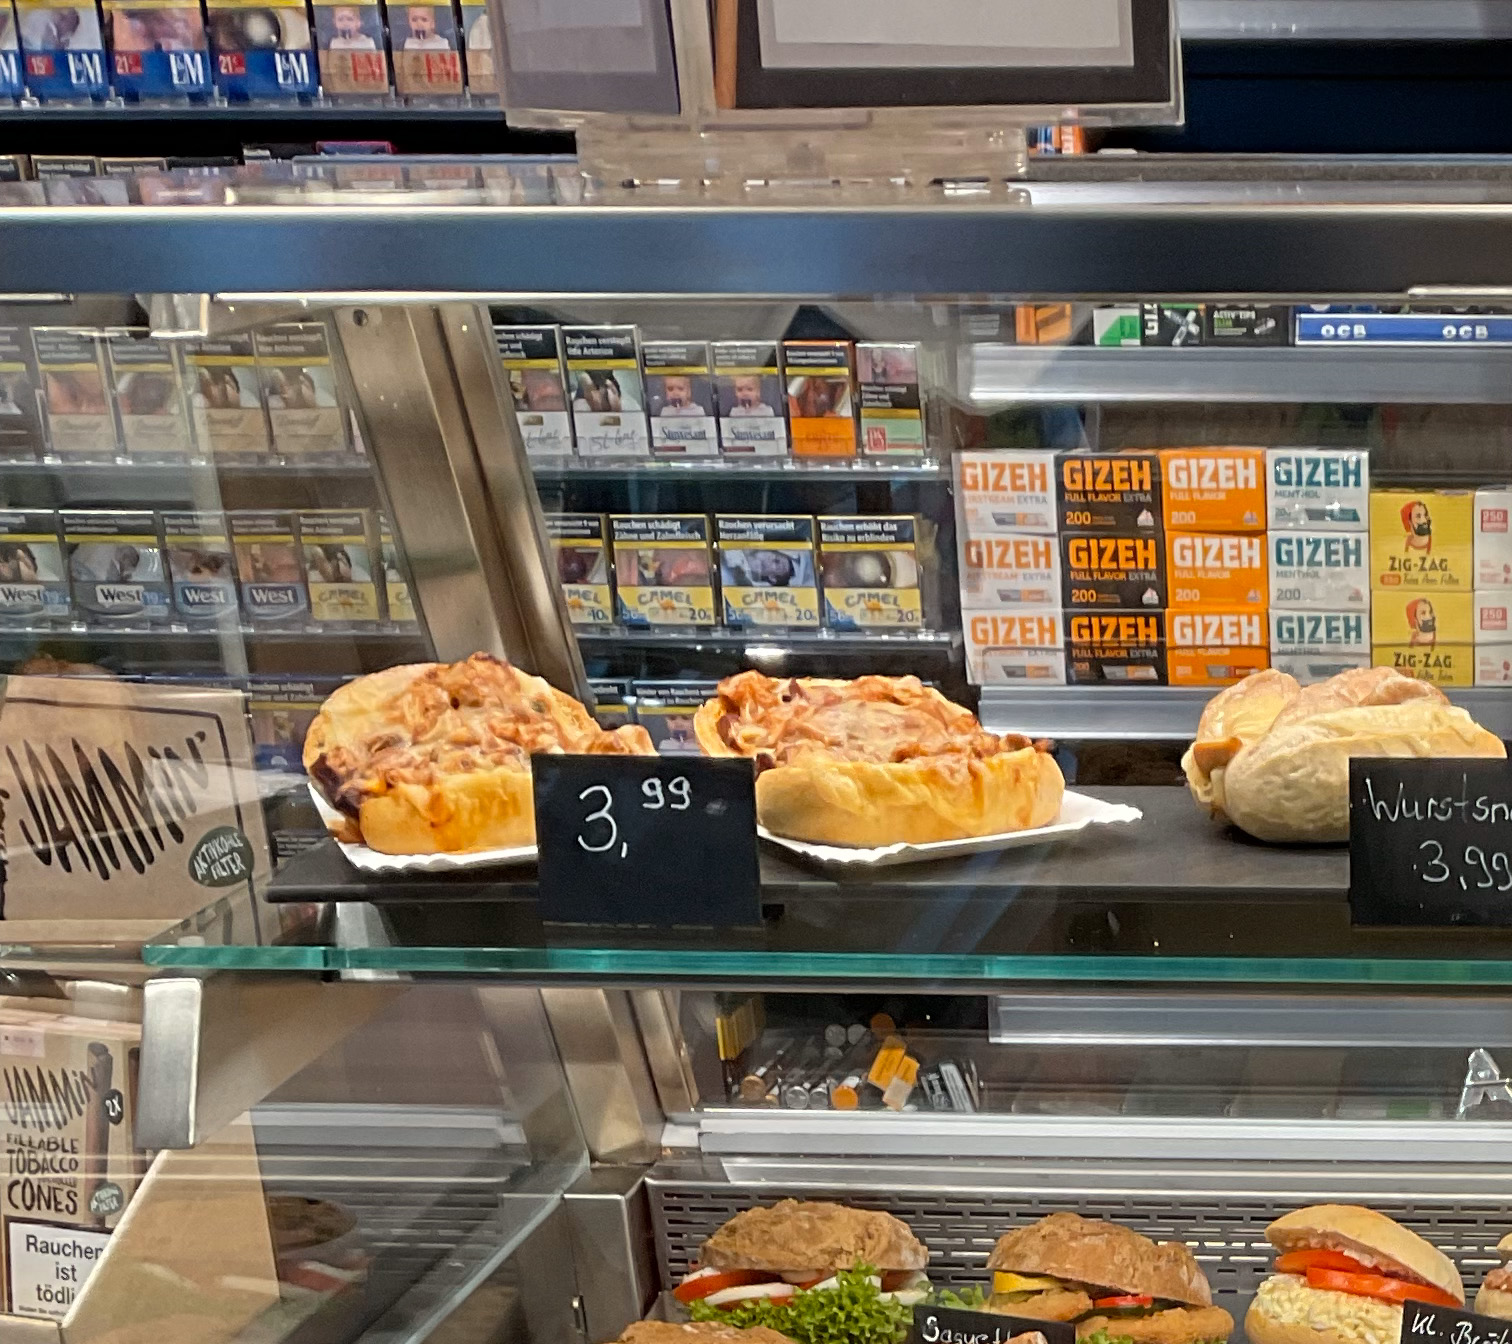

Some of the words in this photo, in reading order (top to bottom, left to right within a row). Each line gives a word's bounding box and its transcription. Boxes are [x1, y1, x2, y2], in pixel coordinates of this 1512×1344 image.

[274, 52, 310, 84] L&M
[1320, 324, 1367, 339] OCB
[1442, 324, 1488, 339] OCB
[961, 461, 1048, 493] GIZEH
[1062, 459, 1151, 492] GIZEH
[1168, 457, 1256, 490] GIZEH
[1273, 456, 1361, 488] GIZEH
[1064, 491, 1086, 502] FULL
[613, 519, 647, 529] Rauchen
[718, 519, 752, 529] Rauchen
[1066, 511, 1091, 526] 200
[1171, 511, 1196, 525] 200
[965, 538, 1052, 570] GIZEH
[1068, 538, 1157, 570] GIZEH
[1173, 536, 1261, 569] GIZEH
[1275, 537, 1362, 568] GIZEH
[1388, 556, 1449, 572] ZIG-ZAG
[2, 586, 43, 600] West
[100, 587, 144, 601] West
[184, 588, 226, 604] West
[252, 588, 294, 604] West
[637, 590, 693, 606] CAMEL
[742, 590, 797, 607] CAMEL
[845, 591, 899, 607] CAMEL
[1071, 589, 1096, 603] 200
[1175, 589, 1200, 603] 200
[1276, 588, 1301, 602] 200
[970, 615, 1057, 646] GIZEH
[1070, 615, 1159, 647] GIZEH
[1173, 614, 1261, 647] GIZEH
[1276, 614, 1362, 645] GIZEH
[1393, 652, 1453, 669] ZIG-ZAG
[210, 852, 247, 882] FILTER
[8, 1150, 79, 1176] TOBACCO
[7, 1177, 78, 1216] CONES
[55, 1262, 77, 1281] ist
[36, 1283, 76, 1305] tödli
